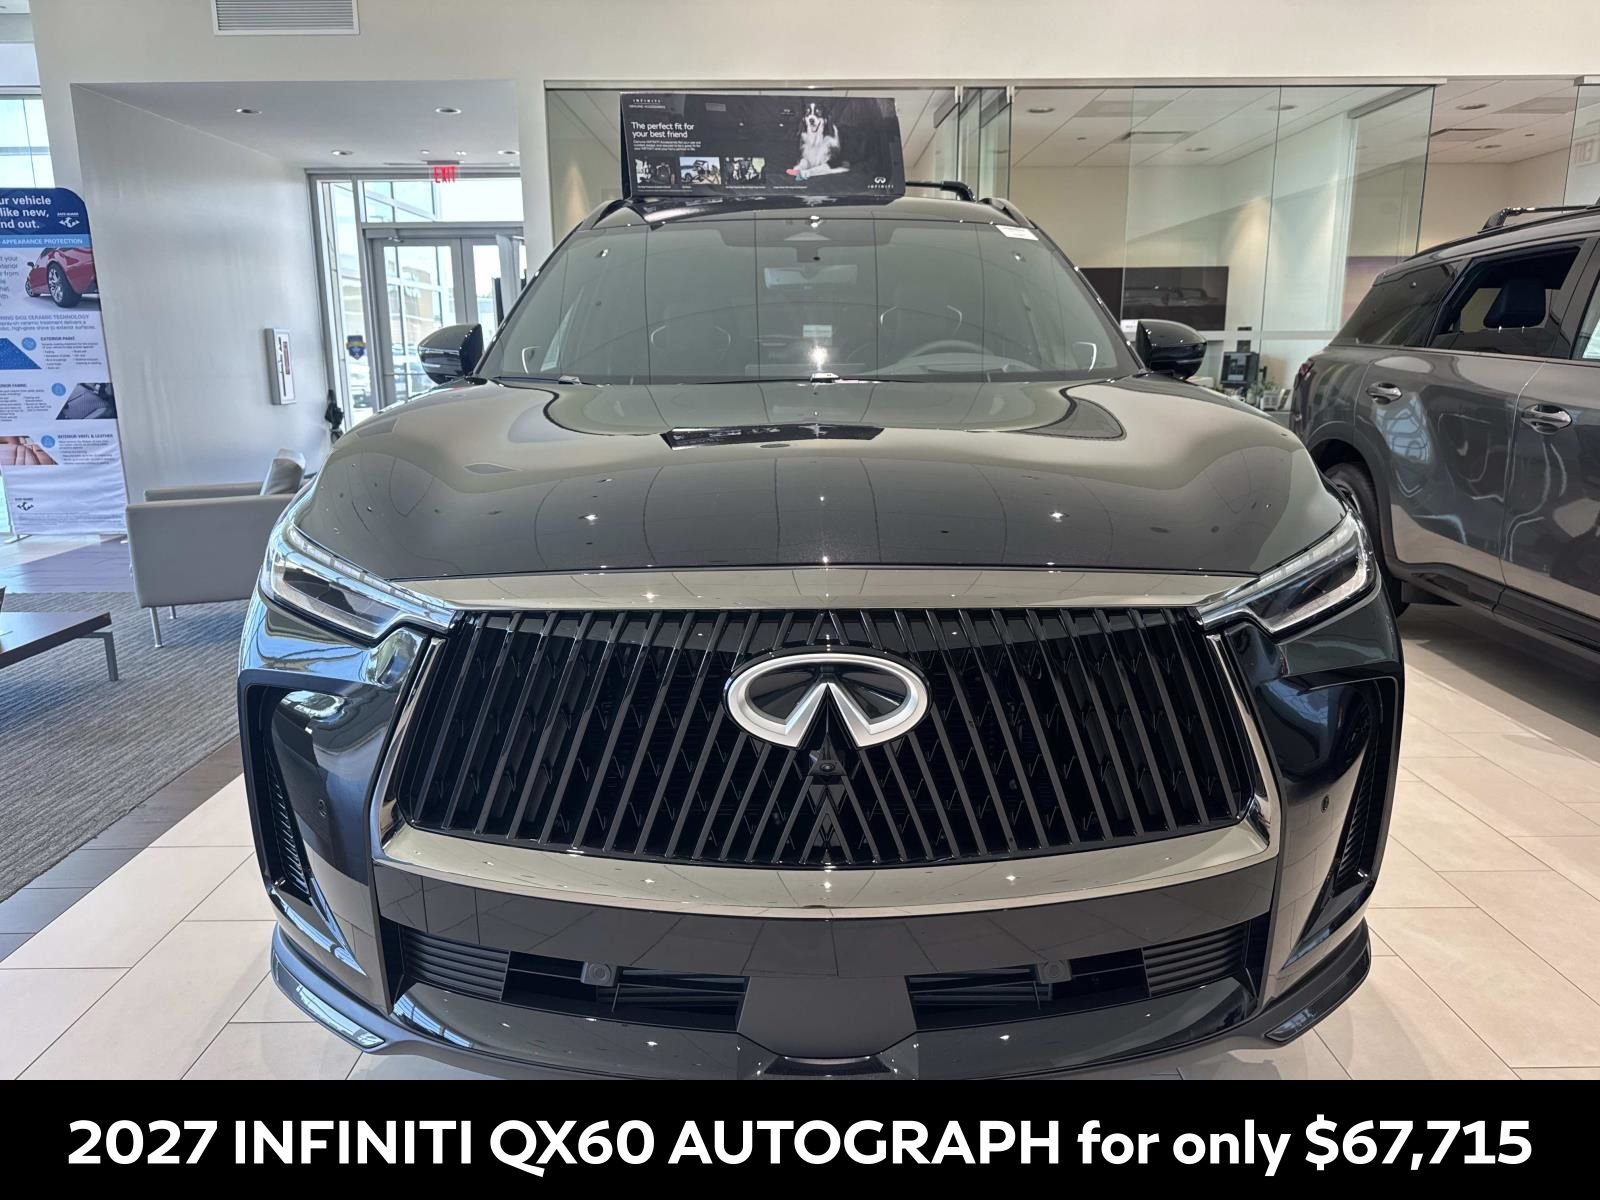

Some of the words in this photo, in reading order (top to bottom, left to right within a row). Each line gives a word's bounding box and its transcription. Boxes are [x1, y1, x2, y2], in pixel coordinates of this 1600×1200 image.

[631, 121, 645, 130] The
[647, 122, 673, 131] perfect
[674, 122, 682, 130] fit
[684, 122, 694, 130] for
[632, 131, 648, 139] your
[650, 130, 665, 138] best
[667, 130, 688, 138] friend
[433, 165, 456, 184] EXIT
[12, 195, 51, 205] vehicle
[0, 208, 19, 217] like
[23, 209, 49, 218] new,
[18, 220, 39, 229] out.
